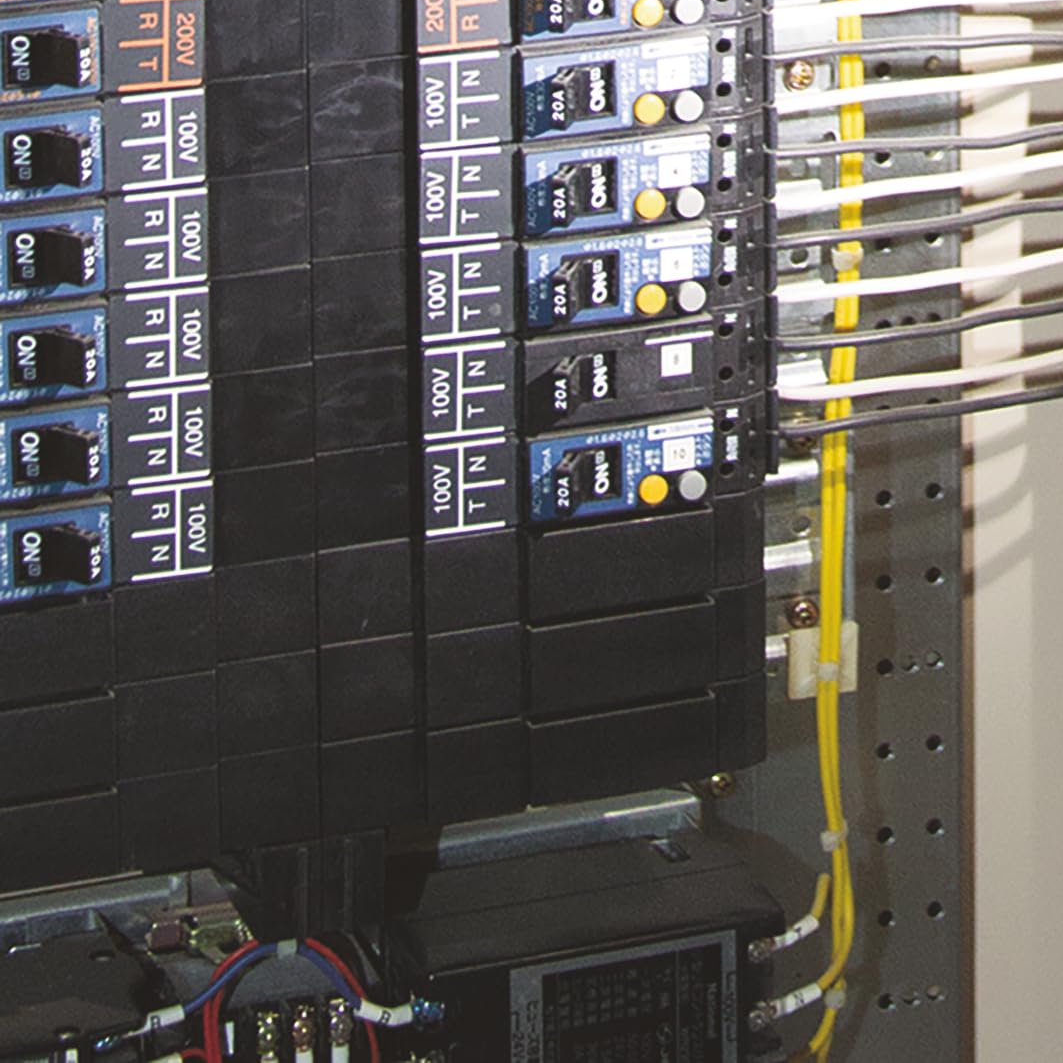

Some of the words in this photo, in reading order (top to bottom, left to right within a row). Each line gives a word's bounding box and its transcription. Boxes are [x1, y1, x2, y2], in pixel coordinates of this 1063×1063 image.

[139, 13, 158, 30] R
[462, 15, 479, 31] R
[11, 36, 30, 66] ON
[176, 13, 195, 65] 200V
[80, 48, 91, 81] 20A
[138, 57, 158, 71] T
[462, 70, 480, 86] N
[426, 77, 444, 127] 100V
[552, 90, 564, 121] 20A
[590, 80, 606, 111] ON
[141, 112, 161, 128] R
[462, 115, 480, 129] T
[13, 135, 31, 165] ON
[178, 111, 199, 162] 100V
[81, 148, 92, 181] 20A
[142, 154, 161, 171] N
[462, 166, 480, 181] N
[426, 172, 444, 222] 100V
[554, 188, 566, 218] 20A
[592, 177, 607, 208] ON
[144, 210, 164, 227] R
[462, 209, 479, 223] T
[15, 234, 34, 264] ON
[182, 211, 201, 261] 100V
[84, 247, 95, 280] 20A
[144, 253, 163, 269] N
[464, 263, 482, 278] N
[428, 270, 446, 319] 100V
[554, 285, 566, 315] 20A
[592, 271, 608, 303] ON
[146, 309, 165, 326] R
[464, 307, 481, 320] T
[183, 309, 201, 360] 100V
[18, 335, 36, 366] ON
[146, 351, 164, 368] N
[85, 349, 96, 383] 20A
[468, 361, 486, 376] N
[432, 369, 450, 417] 100V
[555, 379, 567, 409] 20A
[593, 366, 608, 397] ON
[148, 407, 167, 423] R
[468, 405, 485, 418] T
[21, 432, 39, 462] ON
[184, 407, 204, 457] 100V
[89, 446, 99, 479] 20A
[148, 449, 166, 465] N
[469, 457, 486, 471] N
[433, 465, 451, 513] 100V
[558, 477, 570, 507] 20A
[594, 463, 609, 495] ON
[152, 504, 169, 519] R
[468, 500, 486, 513] T
[188, 503, 206, 553] 100V
[23, 532, 41, 562] ON
[91, 545, 101, 578] 20A
[152, 545, 169, 562] N
